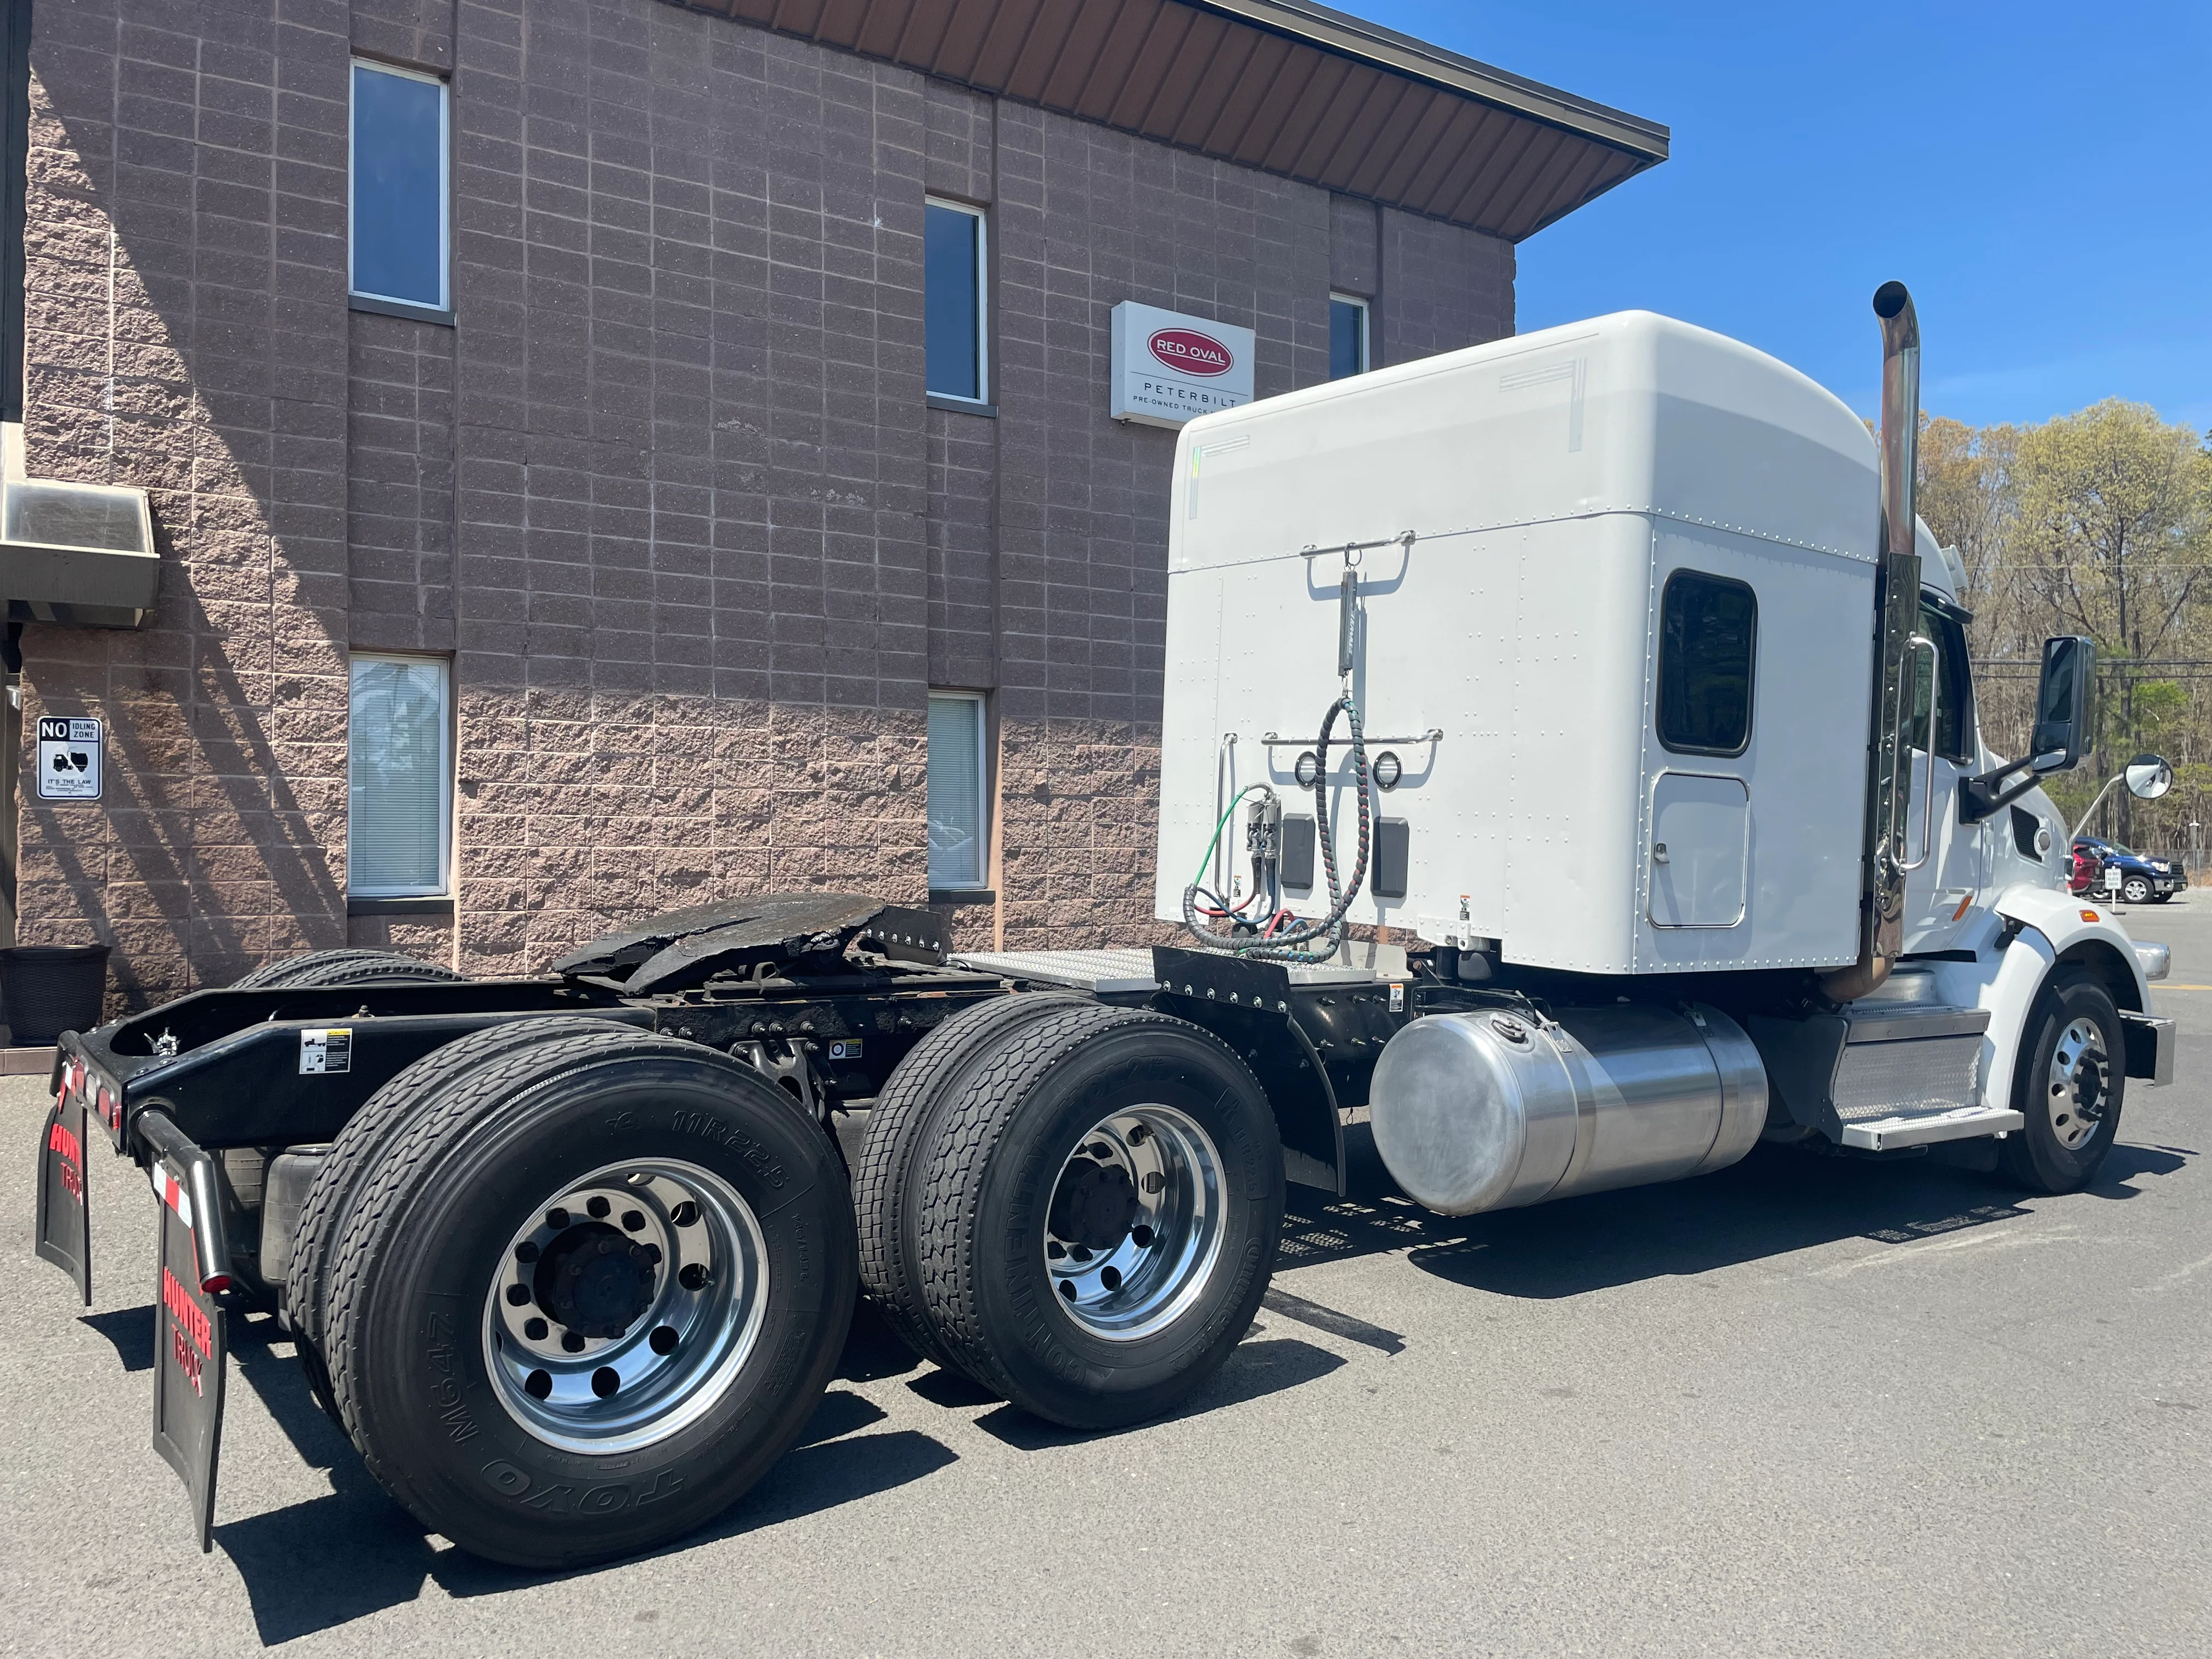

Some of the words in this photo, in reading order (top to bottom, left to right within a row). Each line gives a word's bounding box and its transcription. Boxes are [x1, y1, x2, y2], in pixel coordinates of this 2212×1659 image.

[1156, 339, 1186, 354] RED
[1190, 347, 1226, 363] OVAL
[1133, 395, 1179, 409] PRE-OWNED
[1182, 404, 1207, 415] TRUCK
[1144, 382, 1236, 408] PETERBILT
[42, 721, 67, 738] NO
[163, 1266, 212, 1361] HUNTER
[171, 1323, 203, 1398] TRUCK
[480, 1458, 685, 1515] TOYO
